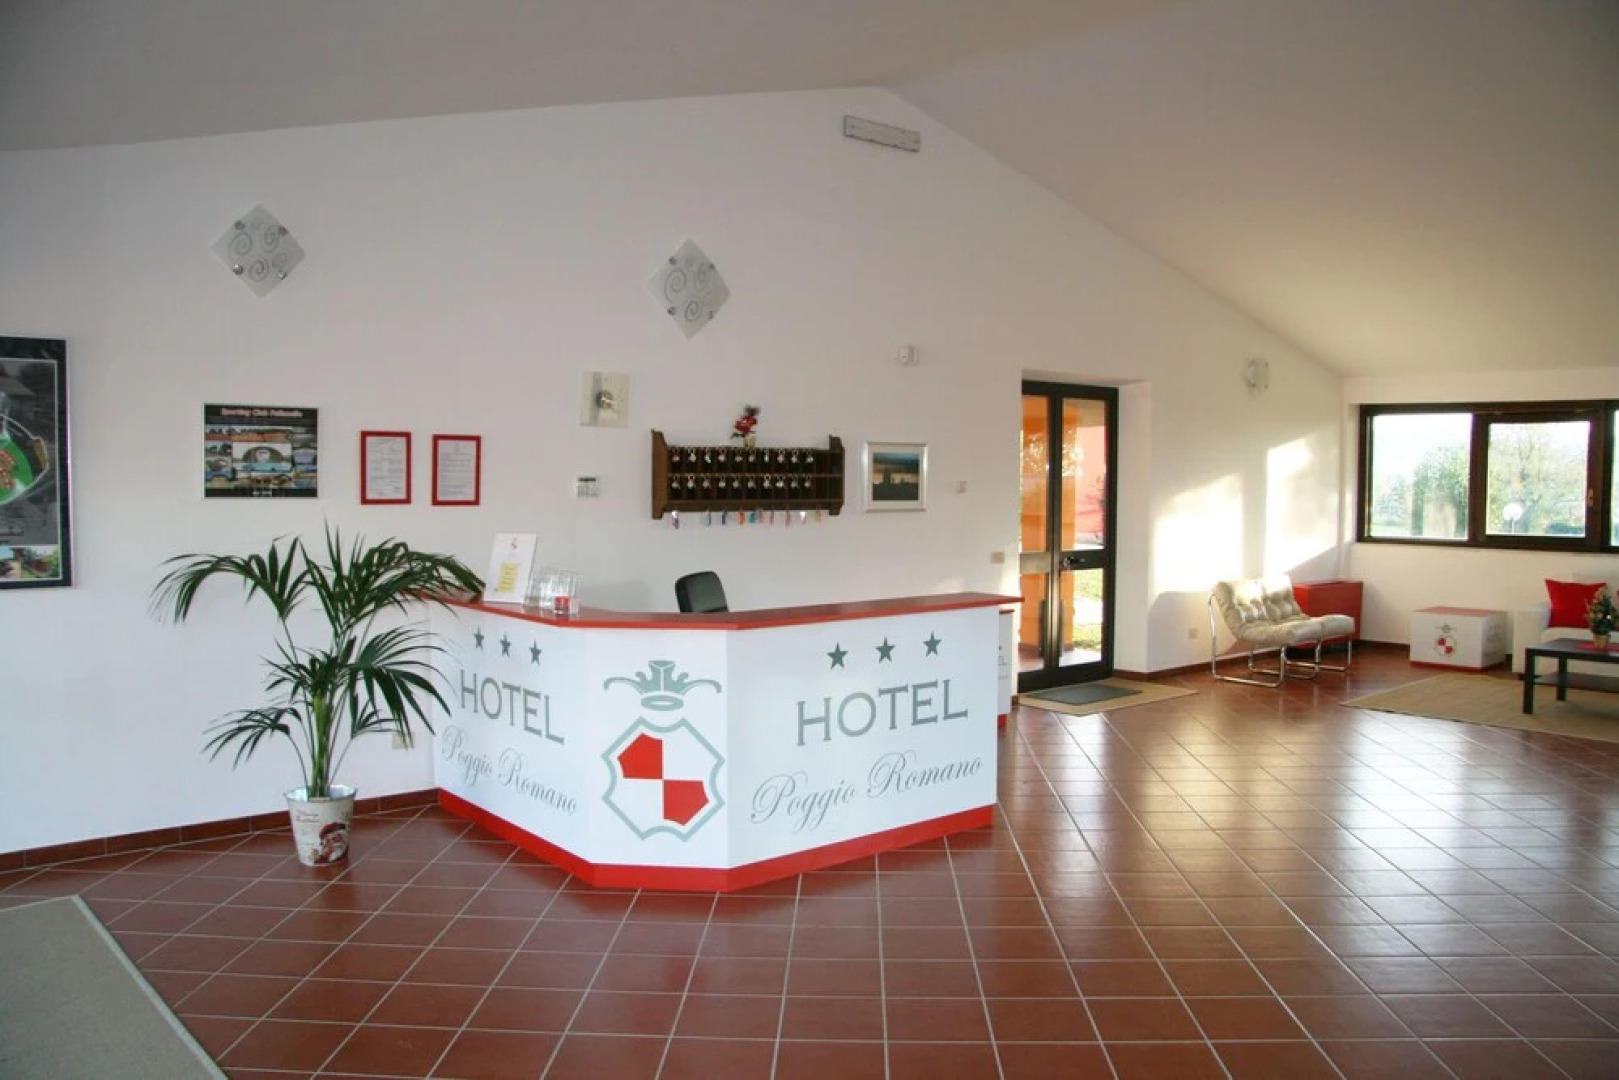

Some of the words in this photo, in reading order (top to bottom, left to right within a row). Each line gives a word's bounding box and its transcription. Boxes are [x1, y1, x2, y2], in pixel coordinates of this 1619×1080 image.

[460, 669, 565, 745] HOTEL
[796, 679, 969, 746] HOTEL
[442, 725, 494, 786] Poggio
[499, 747, 578, 816] Romano
[750, 770, 856, 835] Poggio
[867, 749, 982, 799] Romano
